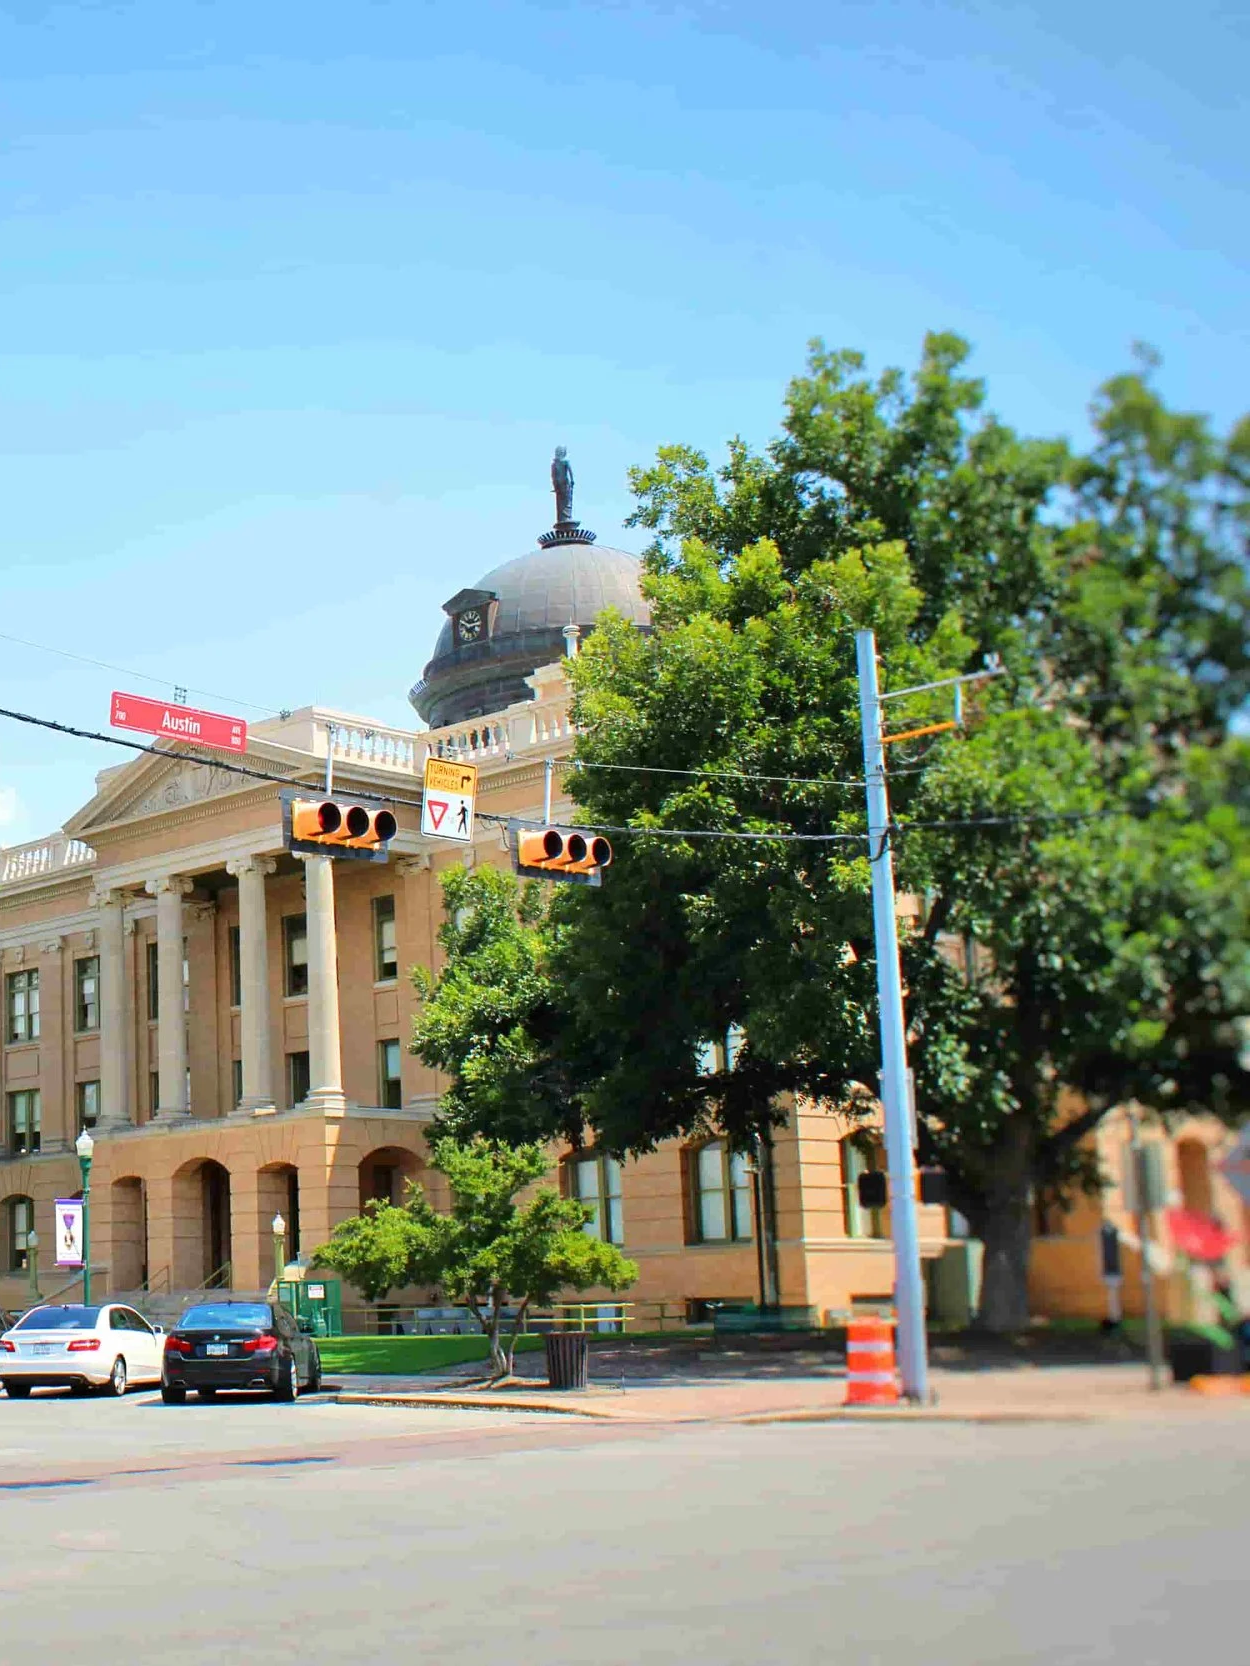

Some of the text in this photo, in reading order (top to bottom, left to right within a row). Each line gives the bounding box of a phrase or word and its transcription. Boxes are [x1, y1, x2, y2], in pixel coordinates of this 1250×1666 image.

[162, 710, 200, 735] Austin
[430, 763, 460, 778] TURNING
[430, 778, 458, 791] VEHICLES
